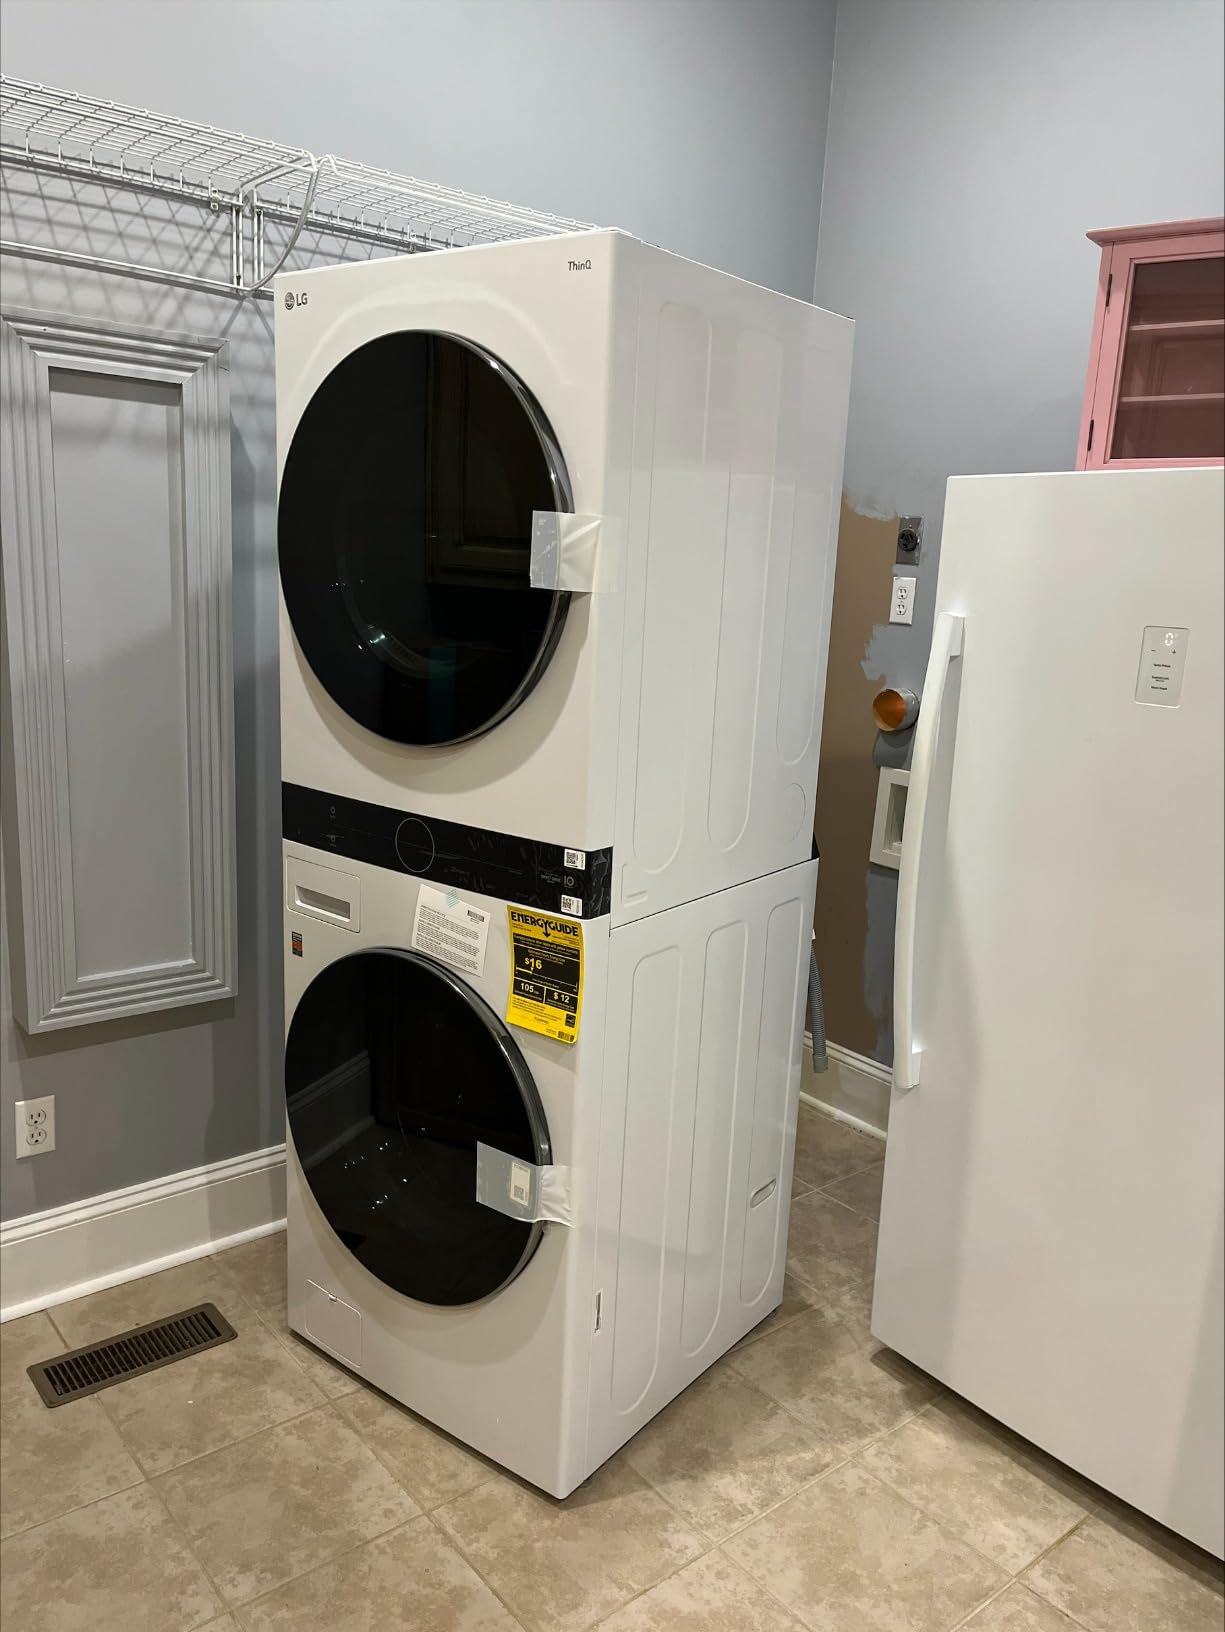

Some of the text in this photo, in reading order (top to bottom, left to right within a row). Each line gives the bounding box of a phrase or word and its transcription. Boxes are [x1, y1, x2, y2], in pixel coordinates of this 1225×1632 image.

[567, 259, 592, 271] ThinQ
[296, 292, 308, 306] LG
[510, 911, 579, 937] ENERGYGUIDE
[524, 957, 543, 970] $16
[520, 982, 534, 993] 105
